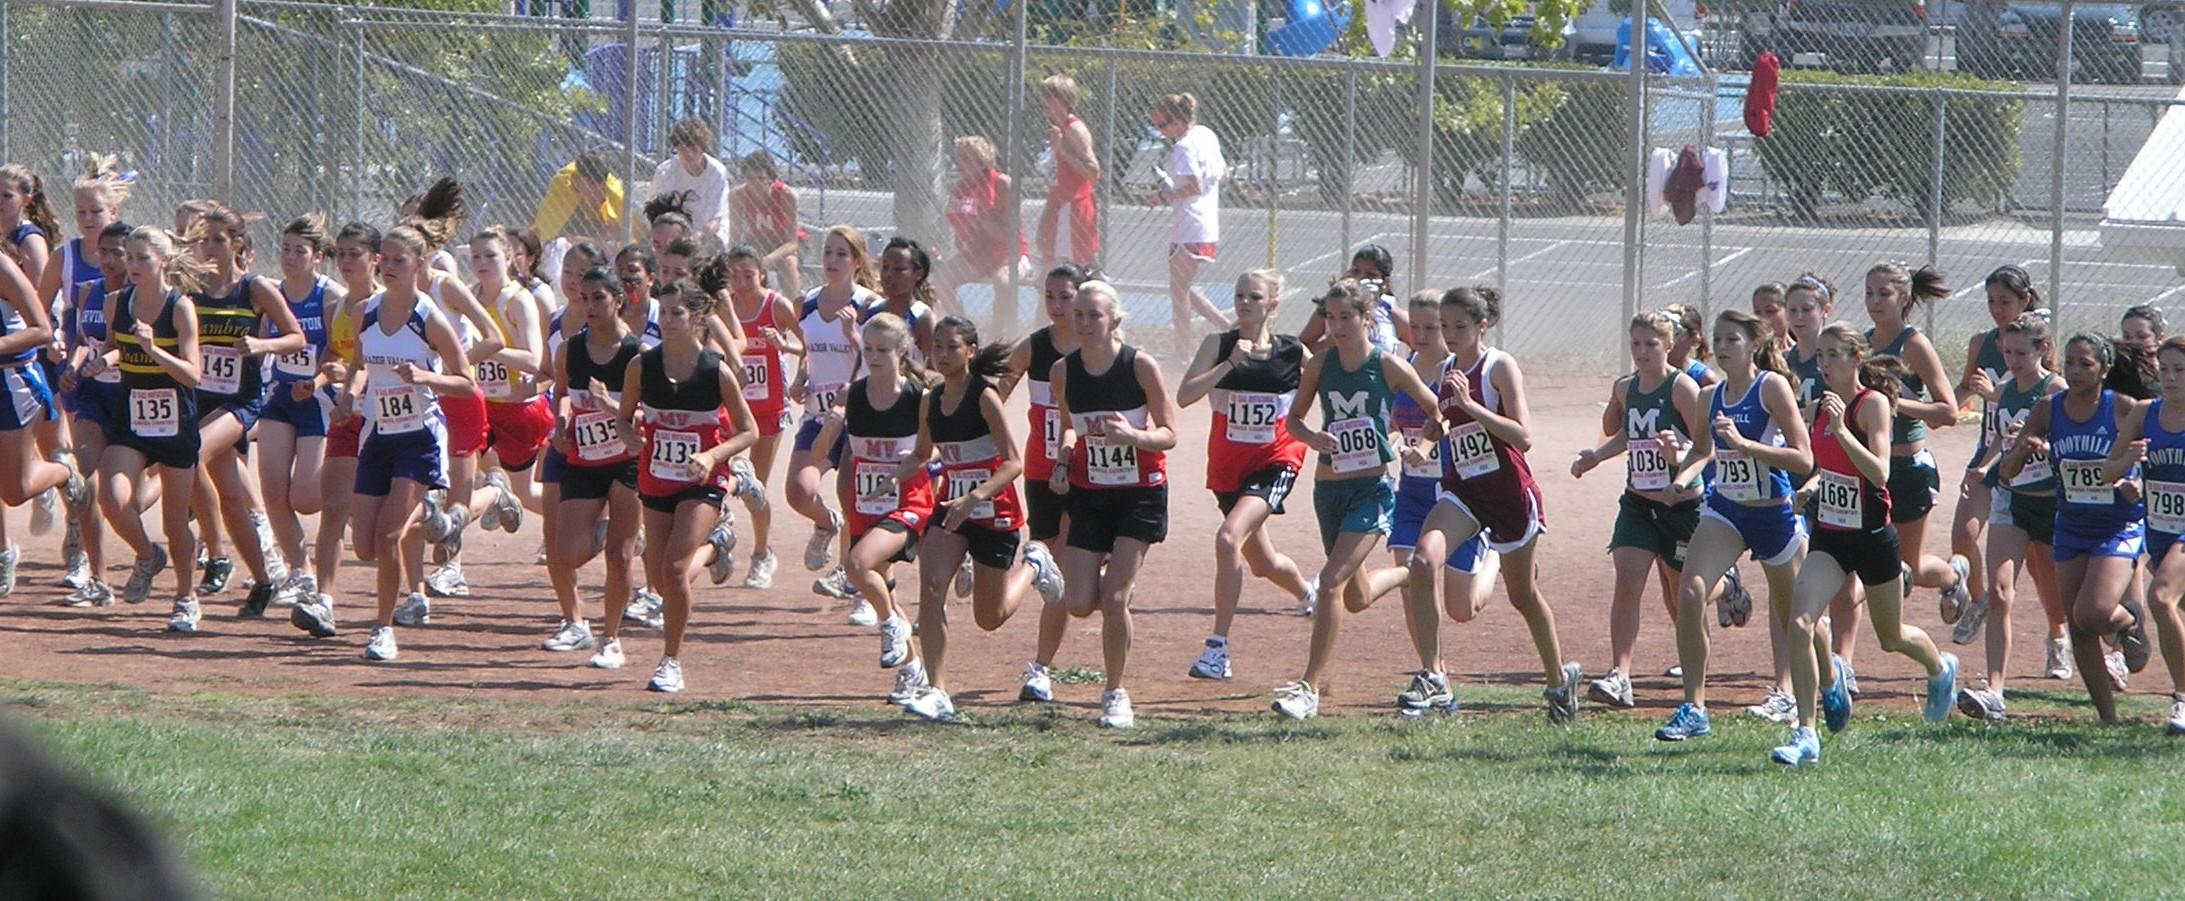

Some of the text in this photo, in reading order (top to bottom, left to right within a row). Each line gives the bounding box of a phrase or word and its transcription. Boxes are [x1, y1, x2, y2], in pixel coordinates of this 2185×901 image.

[201, 319, 251, 337] ambra
[203, 354, 236, 378] 145
[479, 361, 508, 382] 636
[746, 364, 767, 385] 30
[136, 398, 172, 420] 135
[379, 394, 414, 418] 184
[1229, 403, 1276, 426] 1152
[1328, 390, 1369, 420] M
[576, 418, 620, 447] 1135
[1627, 407, 1661, 438] M
[653, 439, 698, 465] 1131
[1330, 427, 1377, 454] 068
[1452, 431, 1494, 463] 1492
[1089, 445, 1136, 468] 1144
[1628, 448, 1667, 473] 1036
[1720, 460, 1751, 483] 793
[2066, 467, 2105, 487] 789
[1820, 480, 1858, 509] 1687
[2151, 491, 2185, 516] 798
